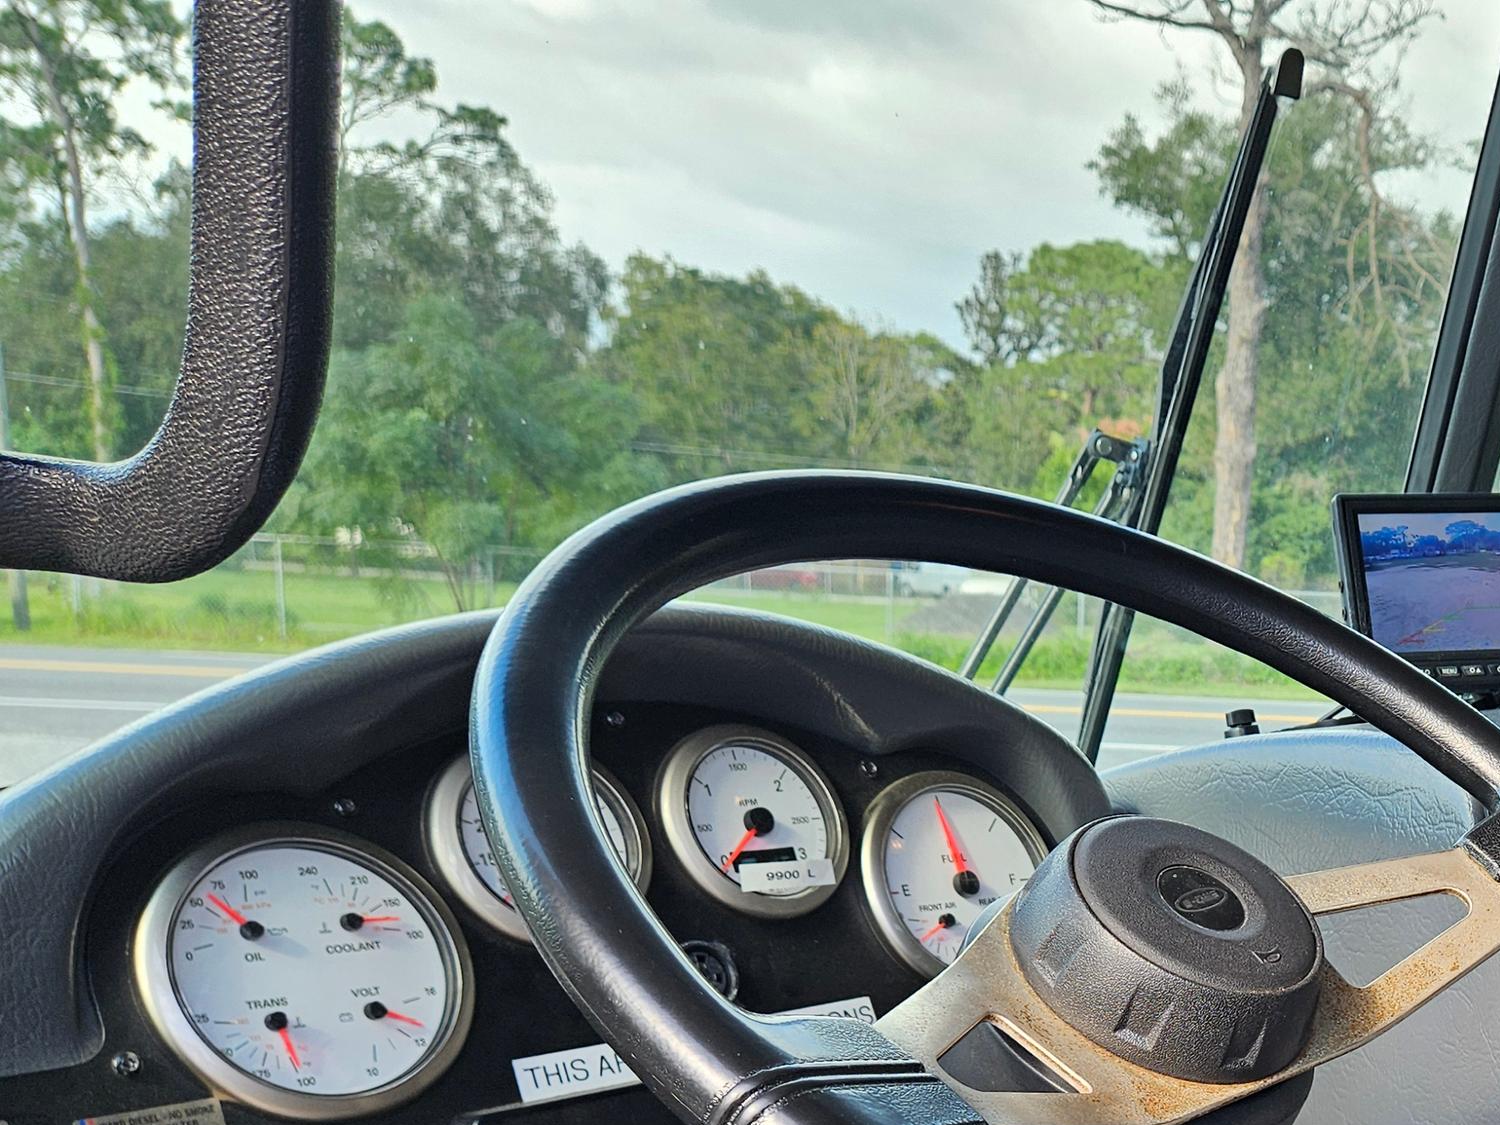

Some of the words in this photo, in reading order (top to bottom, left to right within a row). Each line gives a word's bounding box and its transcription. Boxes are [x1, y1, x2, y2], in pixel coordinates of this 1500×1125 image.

[728, 763, 747, 771] 1500
[773, 779, 783, 792] 2
[738, 798, 758, 806] RPM
[791, 816, 810, 825] 2500
[798, 847, 807, 860] 3
[941, 854, 967, 863] FUL
[239, 870, 258, 880] 100
[298, 867, 318, 876] 240
[766, 870, 800, 881] 9900
[808, 869, 815, 878] L
[350, 875, 369, 885] 210
[211, 881, 226, 890] 75
[901, 884, 912, 897] E
[918, 903, 943, 912] FRONT
[406, 930, 424, 940] 100
[326, 941, 381, 954] COOLANT
[185, 952, 193, 961] 0
[245, 953, 265, 962] OIL
[350, 986, 380, 998] VOLT
[246, 997, 289, 1011] TRANS
[366, 1067, 379, 1077] 10
[523, 1058, 590, 1090] THIS
[297, 1077, 316, 1087] 100
